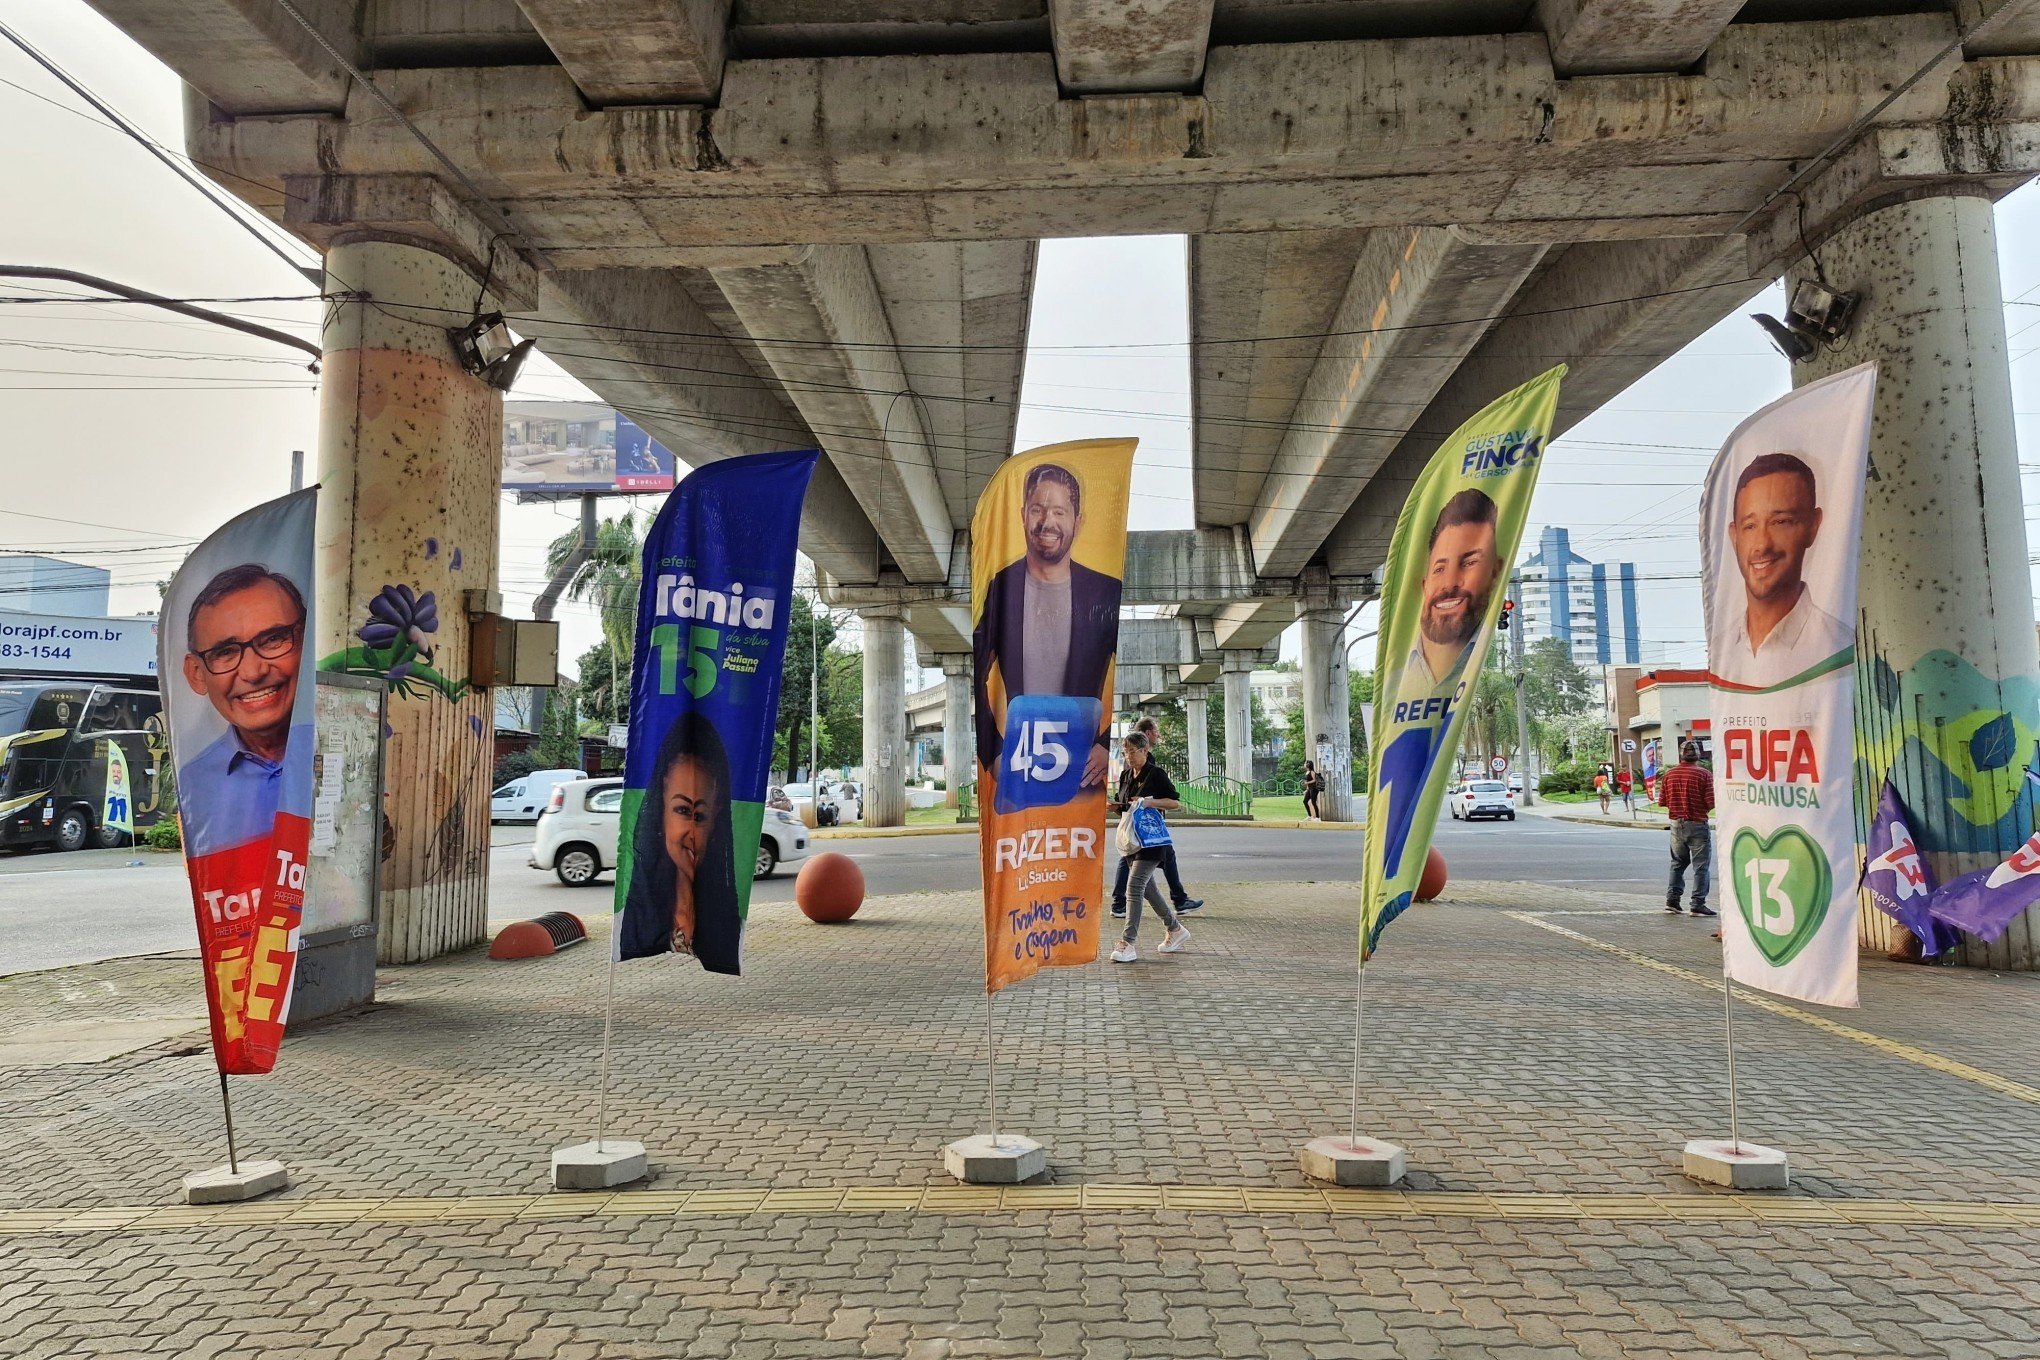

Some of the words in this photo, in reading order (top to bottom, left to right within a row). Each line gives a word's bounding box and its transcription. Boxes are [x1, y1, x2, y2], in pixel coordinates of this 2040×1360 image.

[1461, 435, 1544, 475] FINCK
[656, 574, 775, 630] Tânia
[0, 623, 122, 641] orajpf.com.br
[726, 629, 741, 644] da
[0, 644, 72, 660] 83-1544
[723, 653, 759, 666] Juliano
[725, 646, 741, 654] vice
[651, 623, 720, 700] 15
[722, 661, 757, 673] Passini
[1723, 716, 1767, 727] PREFEITO
[1010, 720, 1069, 782] 45
[1724, 728, 1819, 783] FUFA
[1727, 789, 1746, 802] VICE
[1747, 783, 1820, 809] DANUSA
[995, 827, 1097, 873] RAZER
[277, 849, 307, 892] Ta
[1028, 868, 1067, 885] Saúde
[1744, 857, 1795, 936] 13
[1888, 901, 1903, 912] PT
[1060, 896, 1087, 920] Fé
[1015, 942, 1022, 960] e
